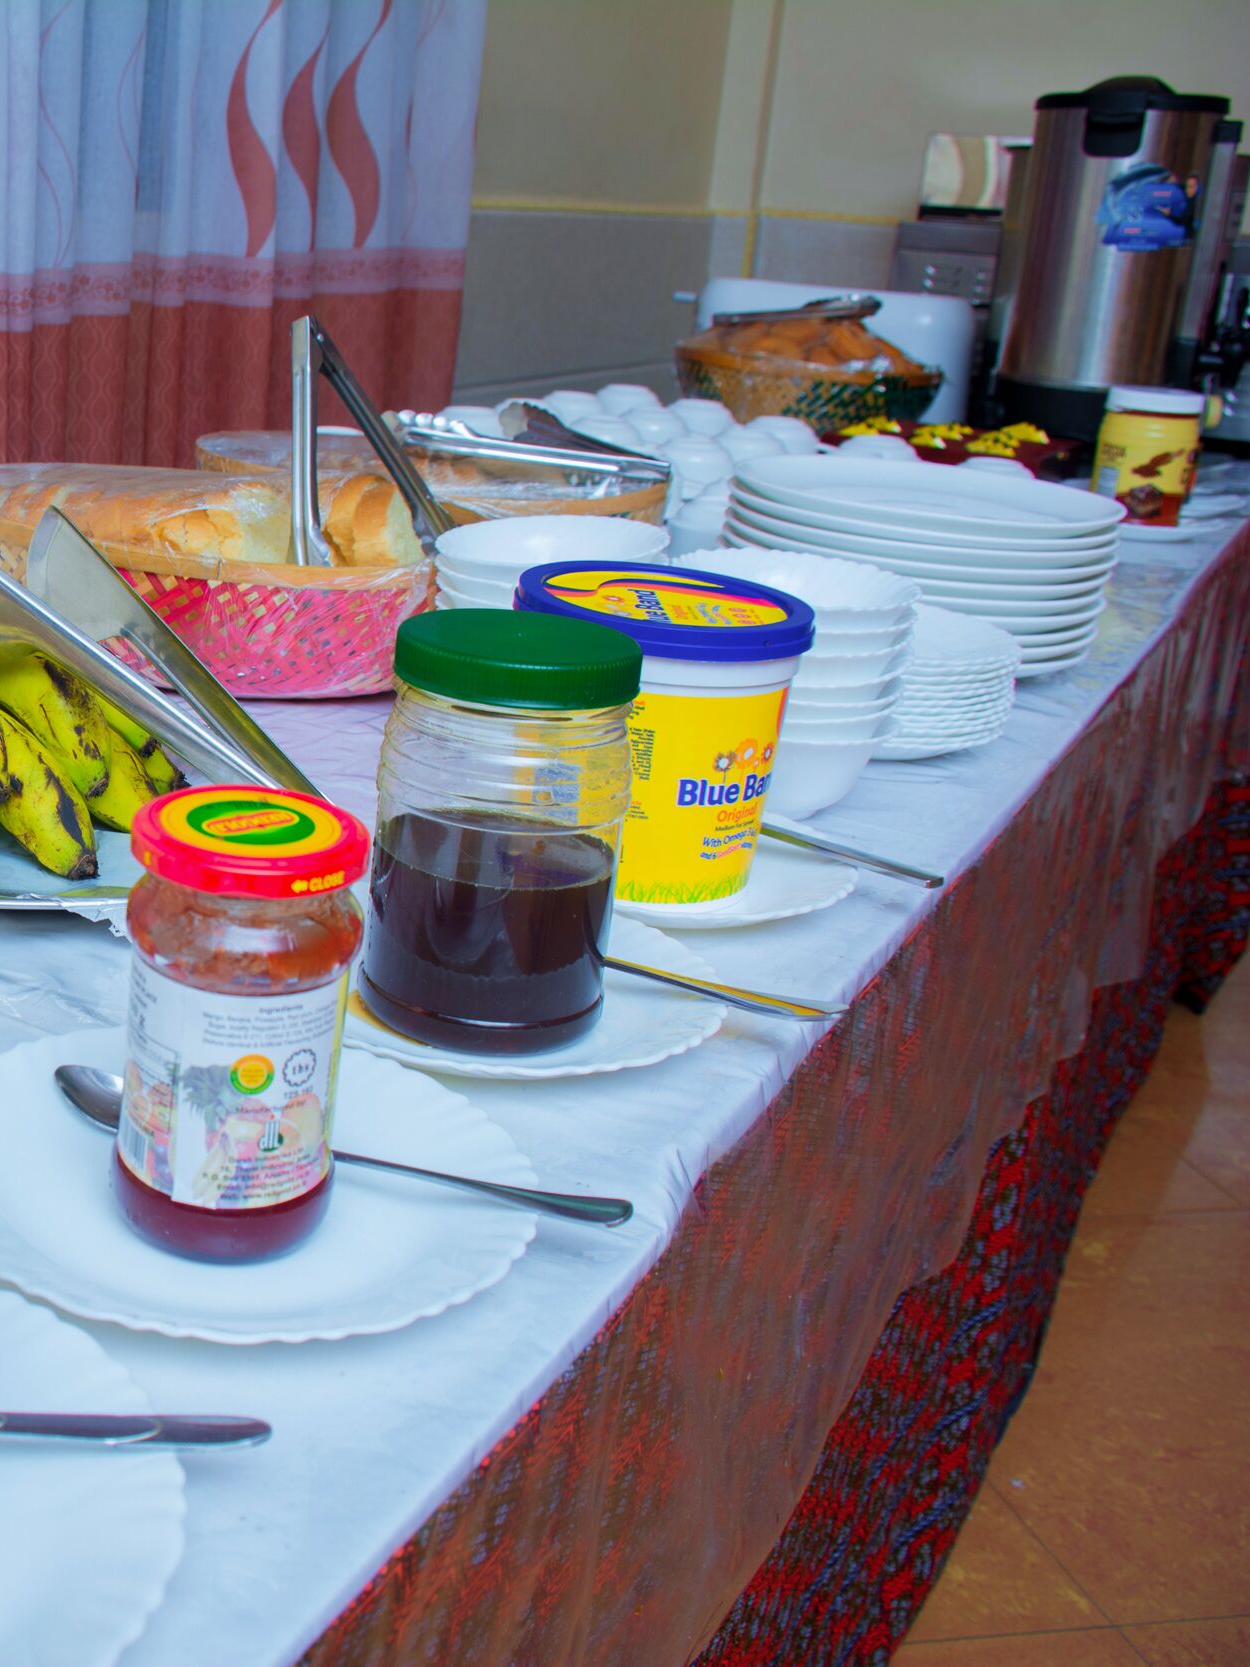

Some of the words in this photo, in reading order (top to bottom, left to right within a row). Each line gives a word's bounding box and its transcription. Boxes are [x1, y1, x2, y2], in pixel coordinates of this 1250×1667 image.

[627, 588, 665, 611] Band
[676, 778, 740, 806] Blue
[717, 802, 759, 823] Original
[703, 836, 722, 848] With
[309, 870, 345, 892] CLOSE
